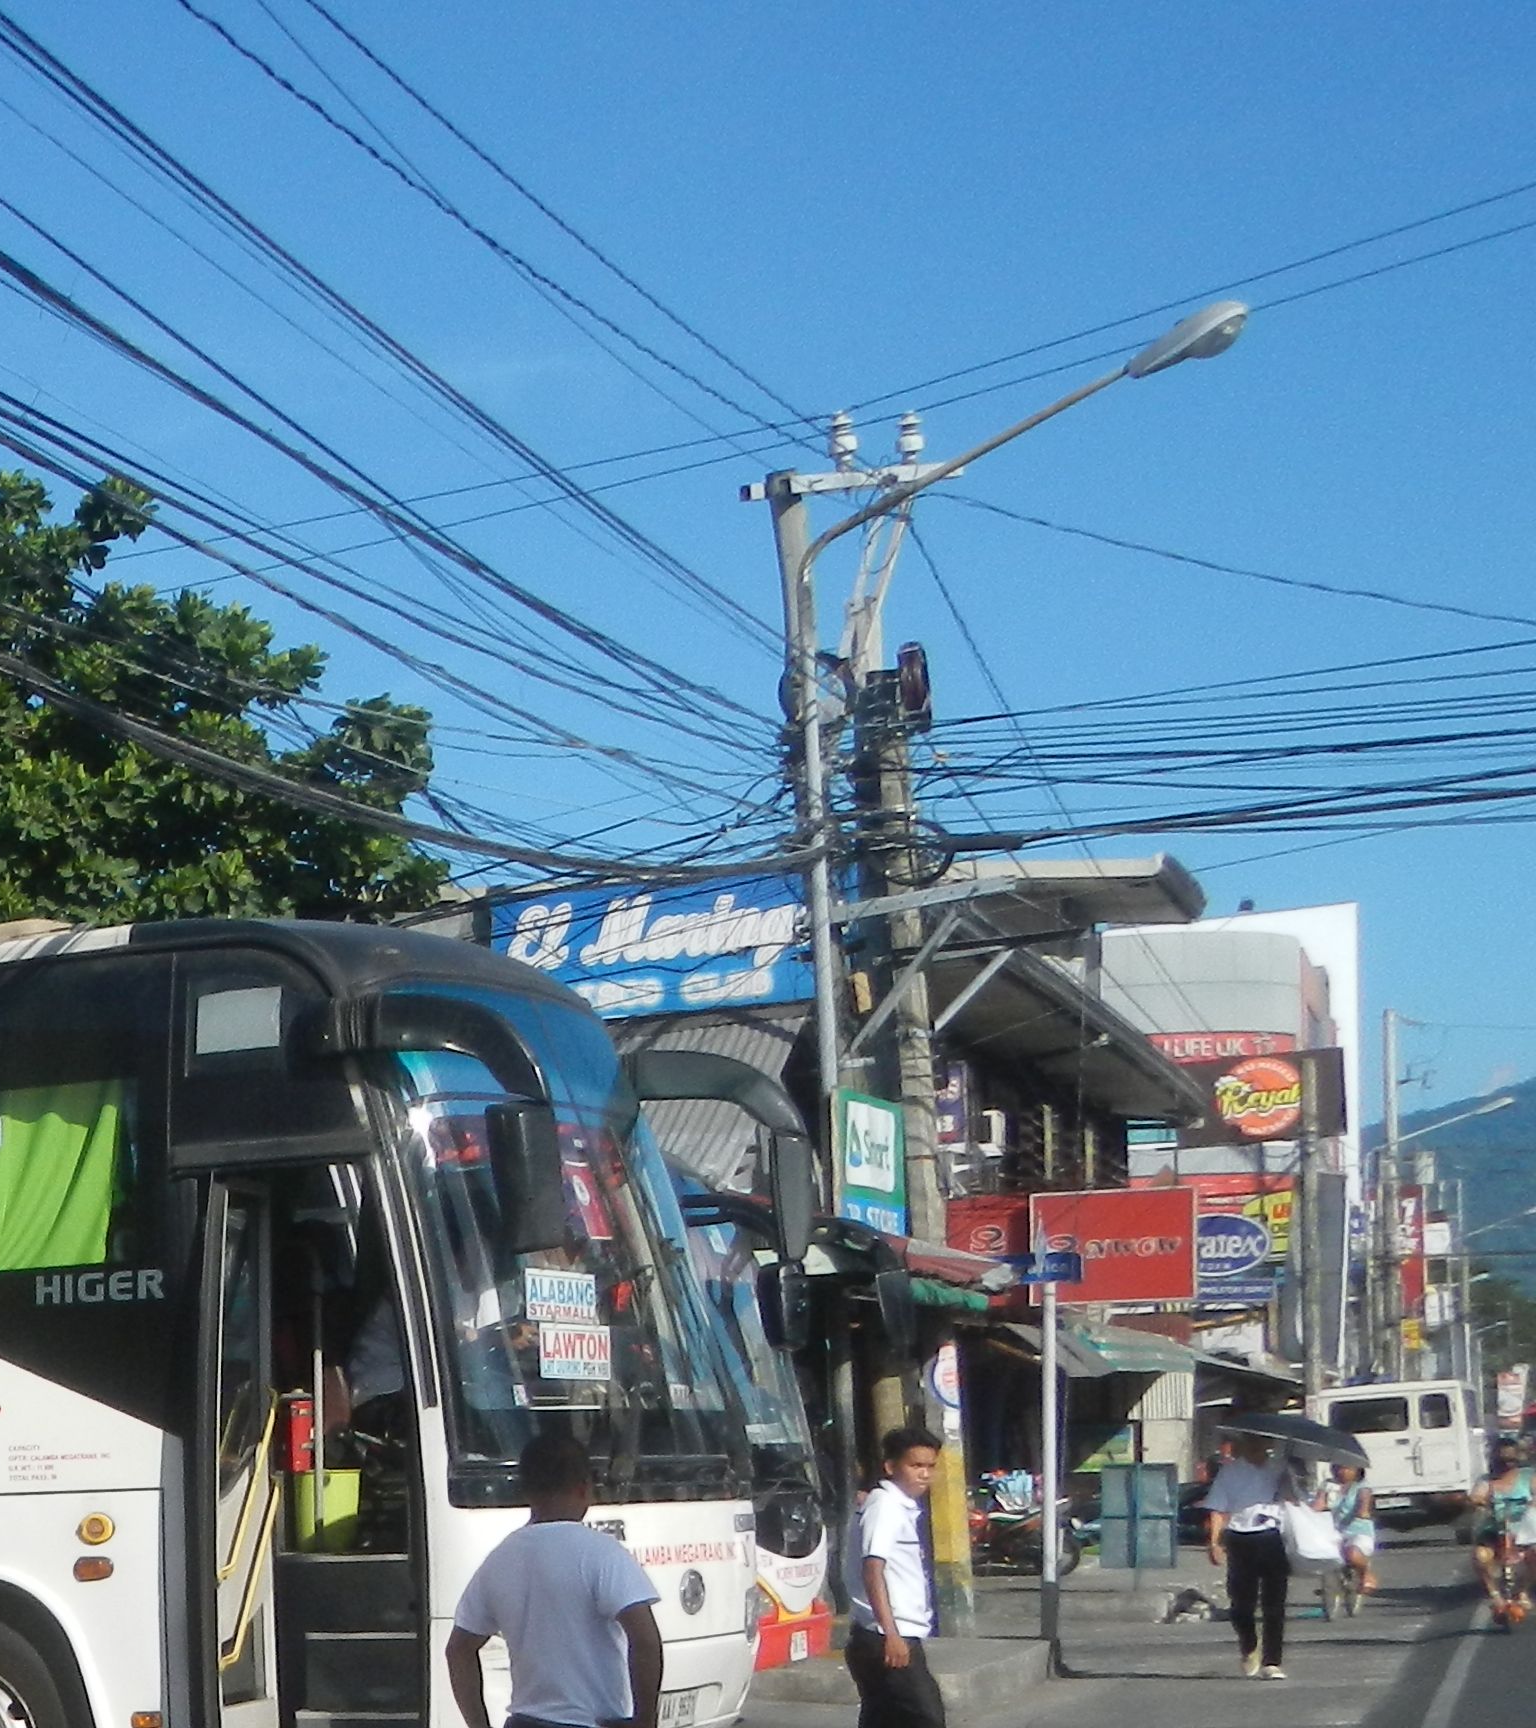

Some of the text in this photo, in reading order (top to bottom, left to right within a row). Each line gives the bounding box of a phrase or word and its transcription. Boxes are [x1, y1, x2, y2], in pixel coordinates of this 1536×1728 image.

[35, 1268, 165, 1305] HIGER
[530, 1278, 594, 1306] ALABANG
[530, 1303, 593, 1320] STARMALL
[543, 1332, 609, 1360] LAWTON
